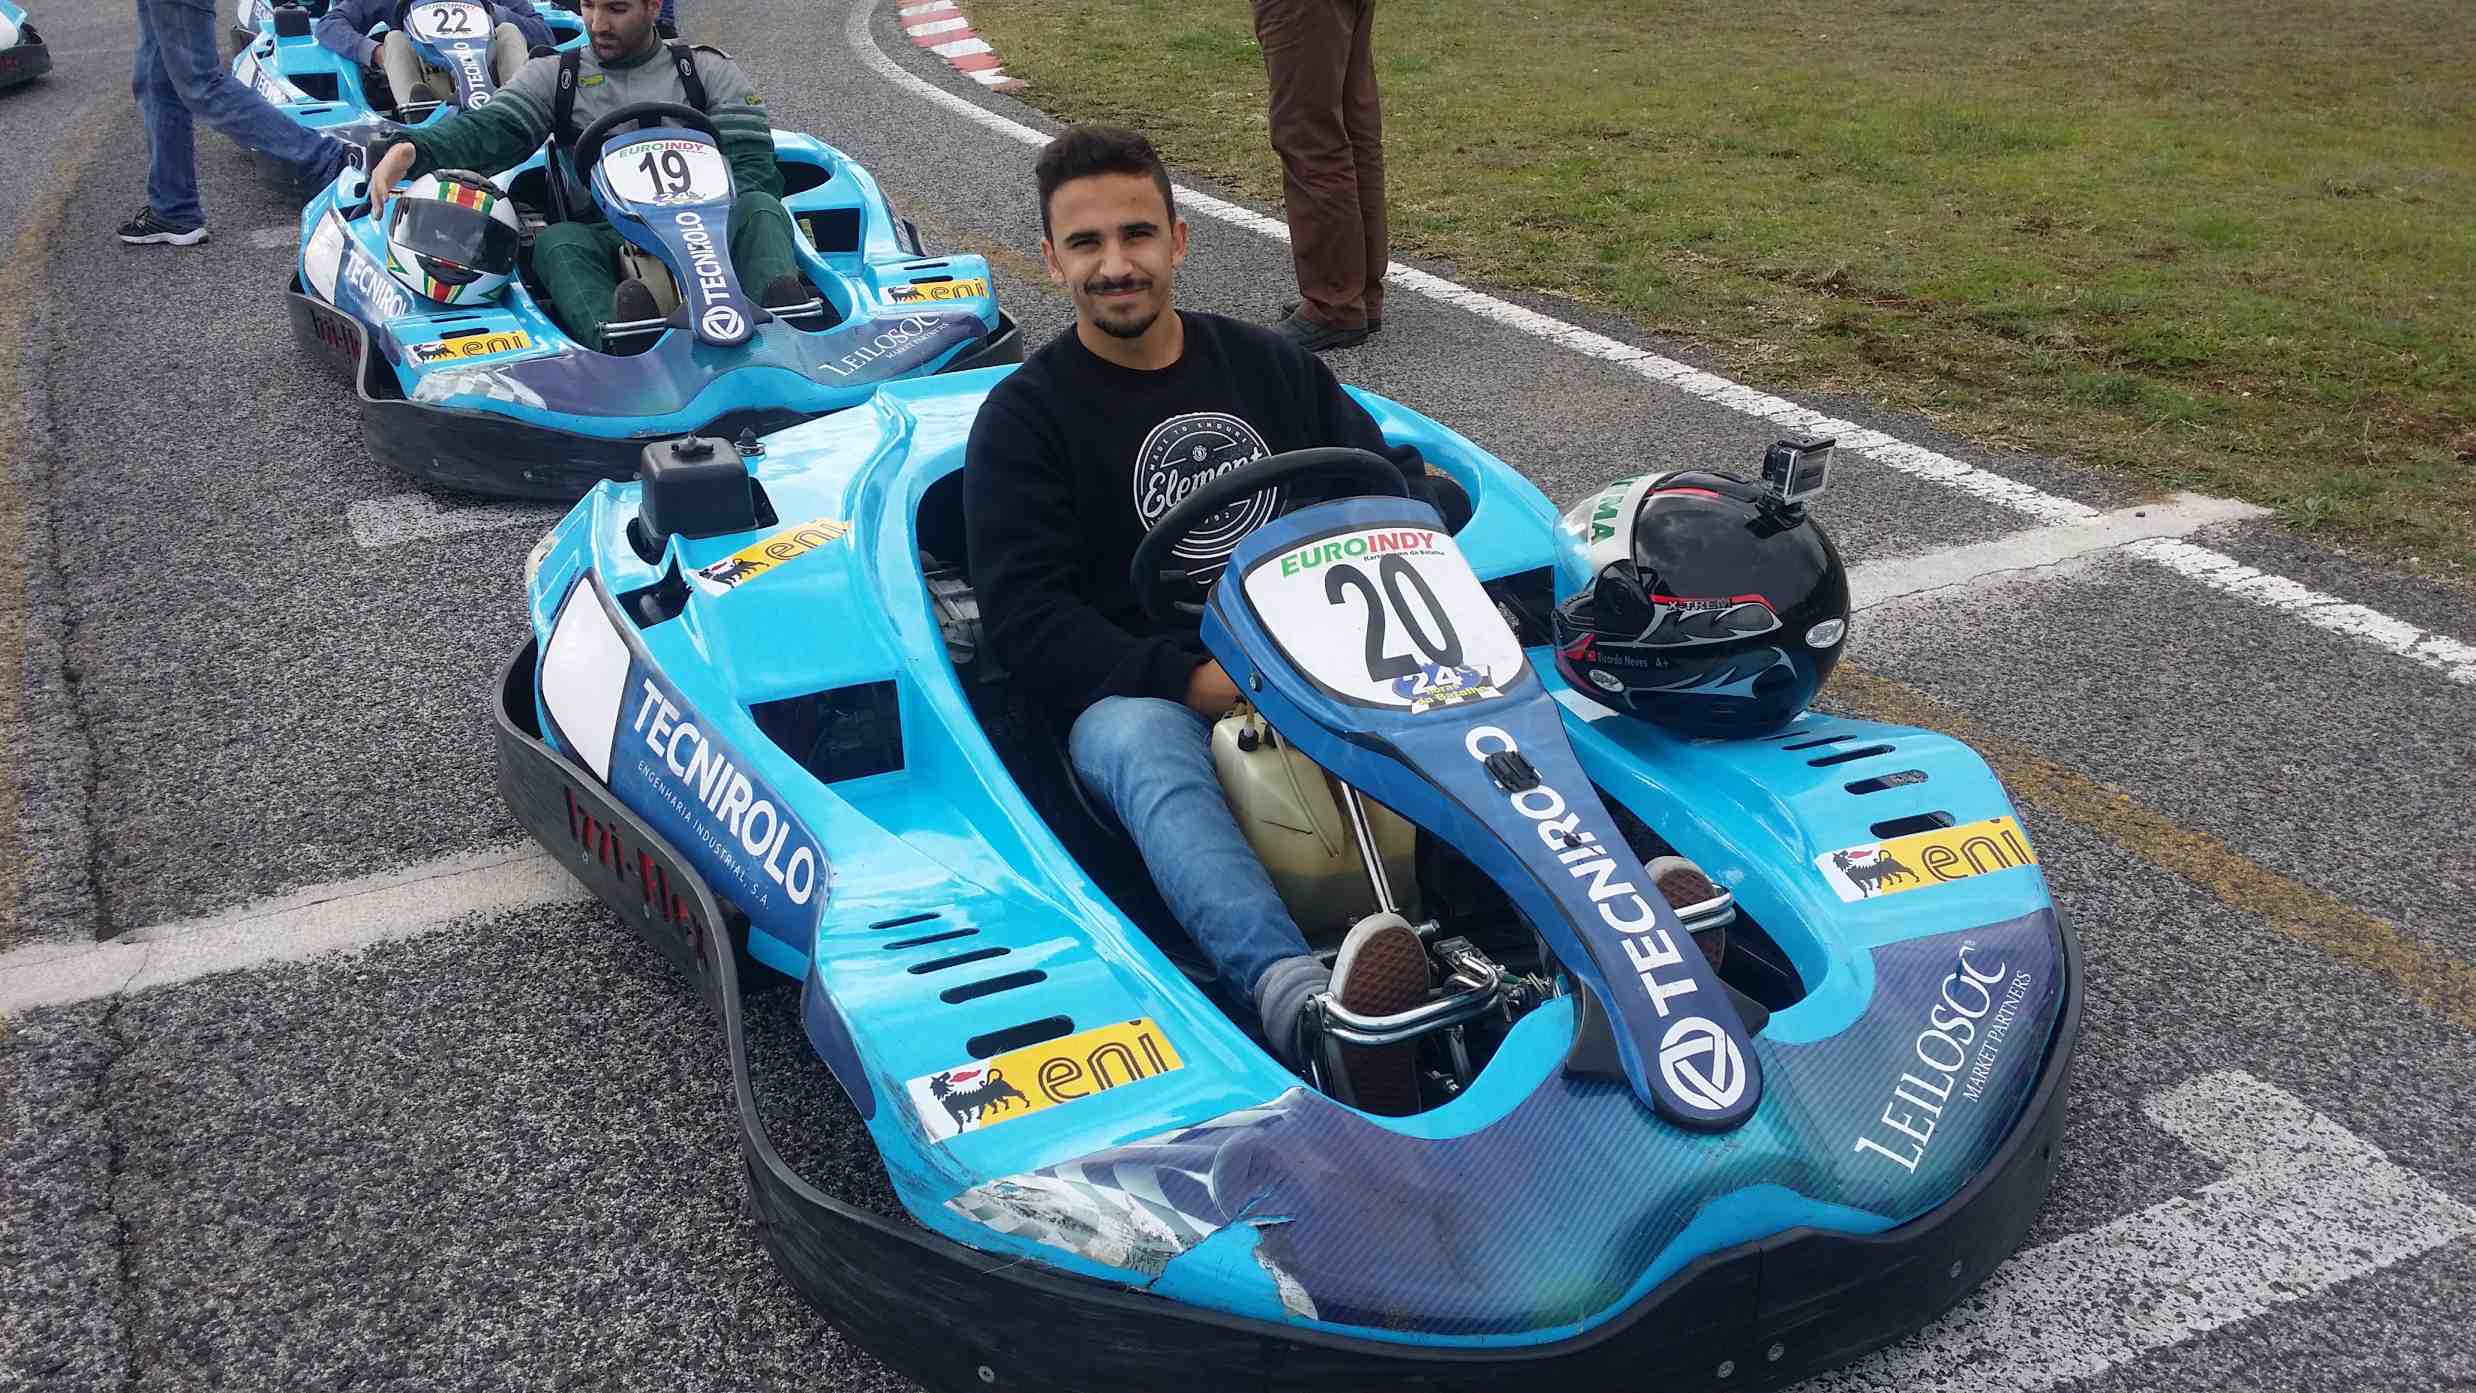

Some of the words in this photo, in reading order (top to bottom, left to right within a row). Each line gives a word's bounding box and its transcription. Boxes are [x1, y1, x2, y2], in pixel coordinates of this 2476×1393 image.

[433, 8, 472, 32] 22
[619, 142, 705, 158] EUROINDY
[638, 150, 692, 194] 19
[675, 211, 731, 305] TECNIROLO
[462, 331, 525, 357] eni
[1280, 532, 1434, 577] EUROINDY
[1324, 553, 1464, 683] 20
[634, 677, 815, 905] TECNIROLO
[638, 760, 691, 823] ENGENHARIA
[1465, 726, 1698, 1017] TECNIROO
[1921, 818, 2032, 882] eni
[1038, 1019, 1169, 1104] eni
[1854, 945, 2006, 1175] LEILOSOC
[1962, 1040, 1998, 1103] MARKET
[1986, 970, 2032, 1044] PARTNERS
